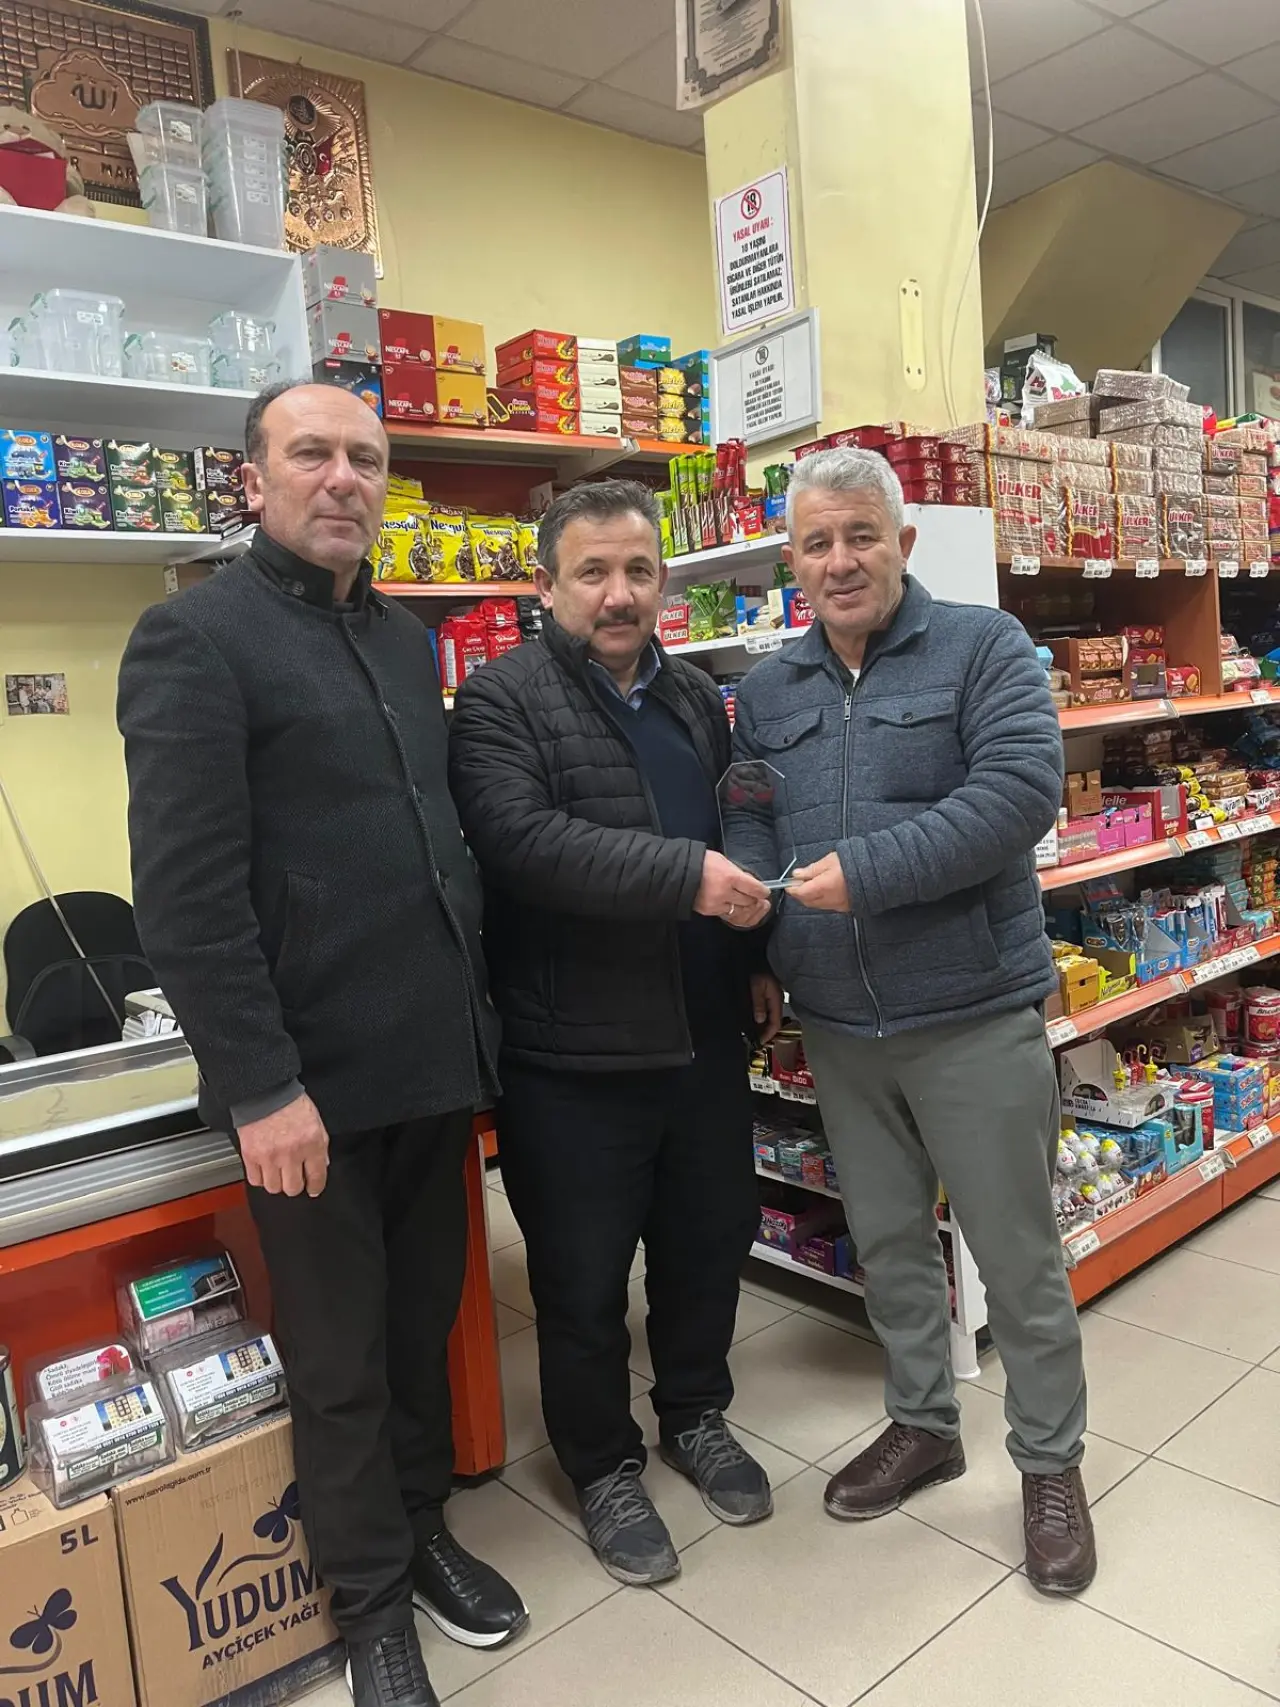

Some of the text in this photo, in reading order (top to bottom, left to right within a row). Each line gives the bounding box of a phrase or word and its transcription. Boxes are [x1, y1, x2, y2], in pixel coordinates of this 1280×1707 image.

[733, 226, 751, 242] YASAL
[732, 289, 756, 307] SATANLAR
[731, 306, 747, 319] YASAL
[998, 474, 1042, 500] ÜLKER
[202, 1600, 321, 1670] AYÇİÇEK YAĞI
